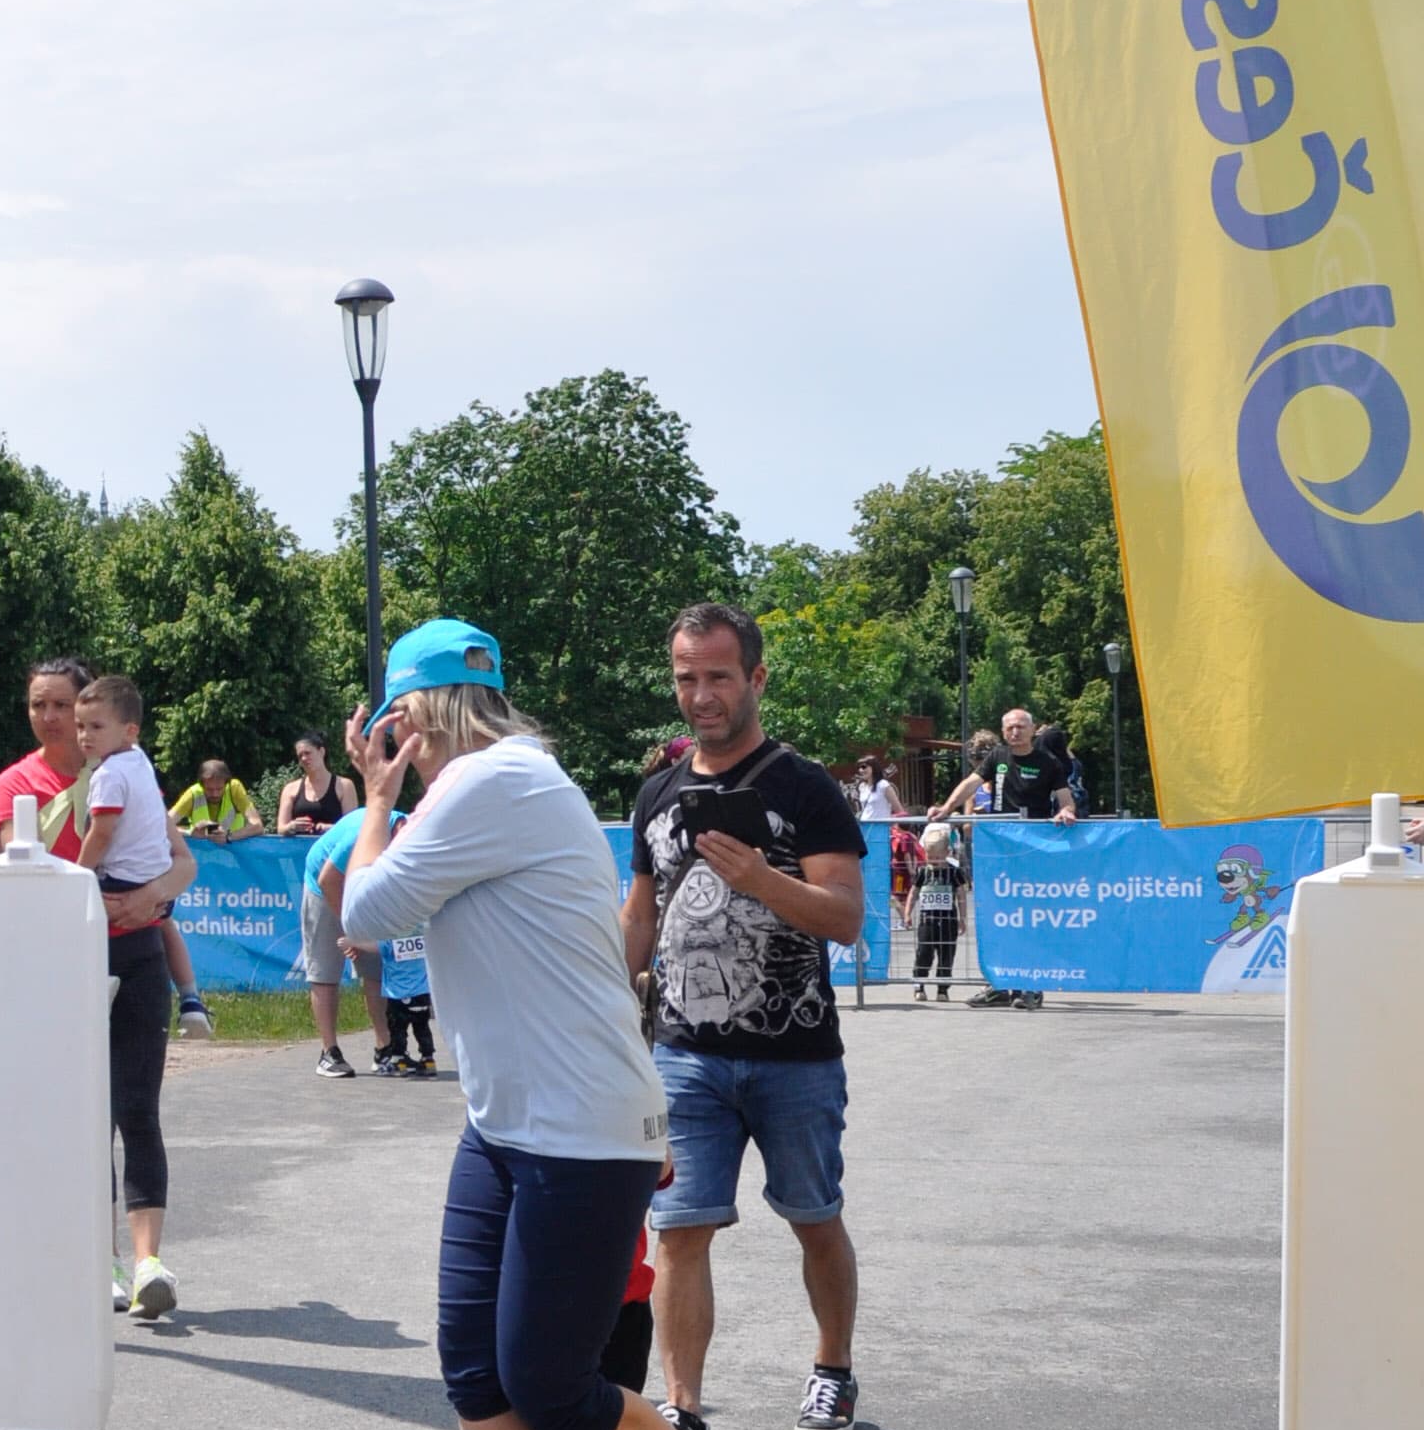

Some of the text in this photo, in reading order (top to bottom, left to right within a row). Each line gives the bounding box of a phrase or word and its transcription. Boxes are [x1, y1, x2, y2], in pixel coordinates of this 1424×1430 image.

[993, 871, 1203, 903] Úrazové pojištění
[175, 886, 294, 912] aši rodinu,
[993, 906, 1098, 929] od PVZP
[395, 937, 425, 953] 206
[993, 965, 1086, 982] www.pvzp.cz
